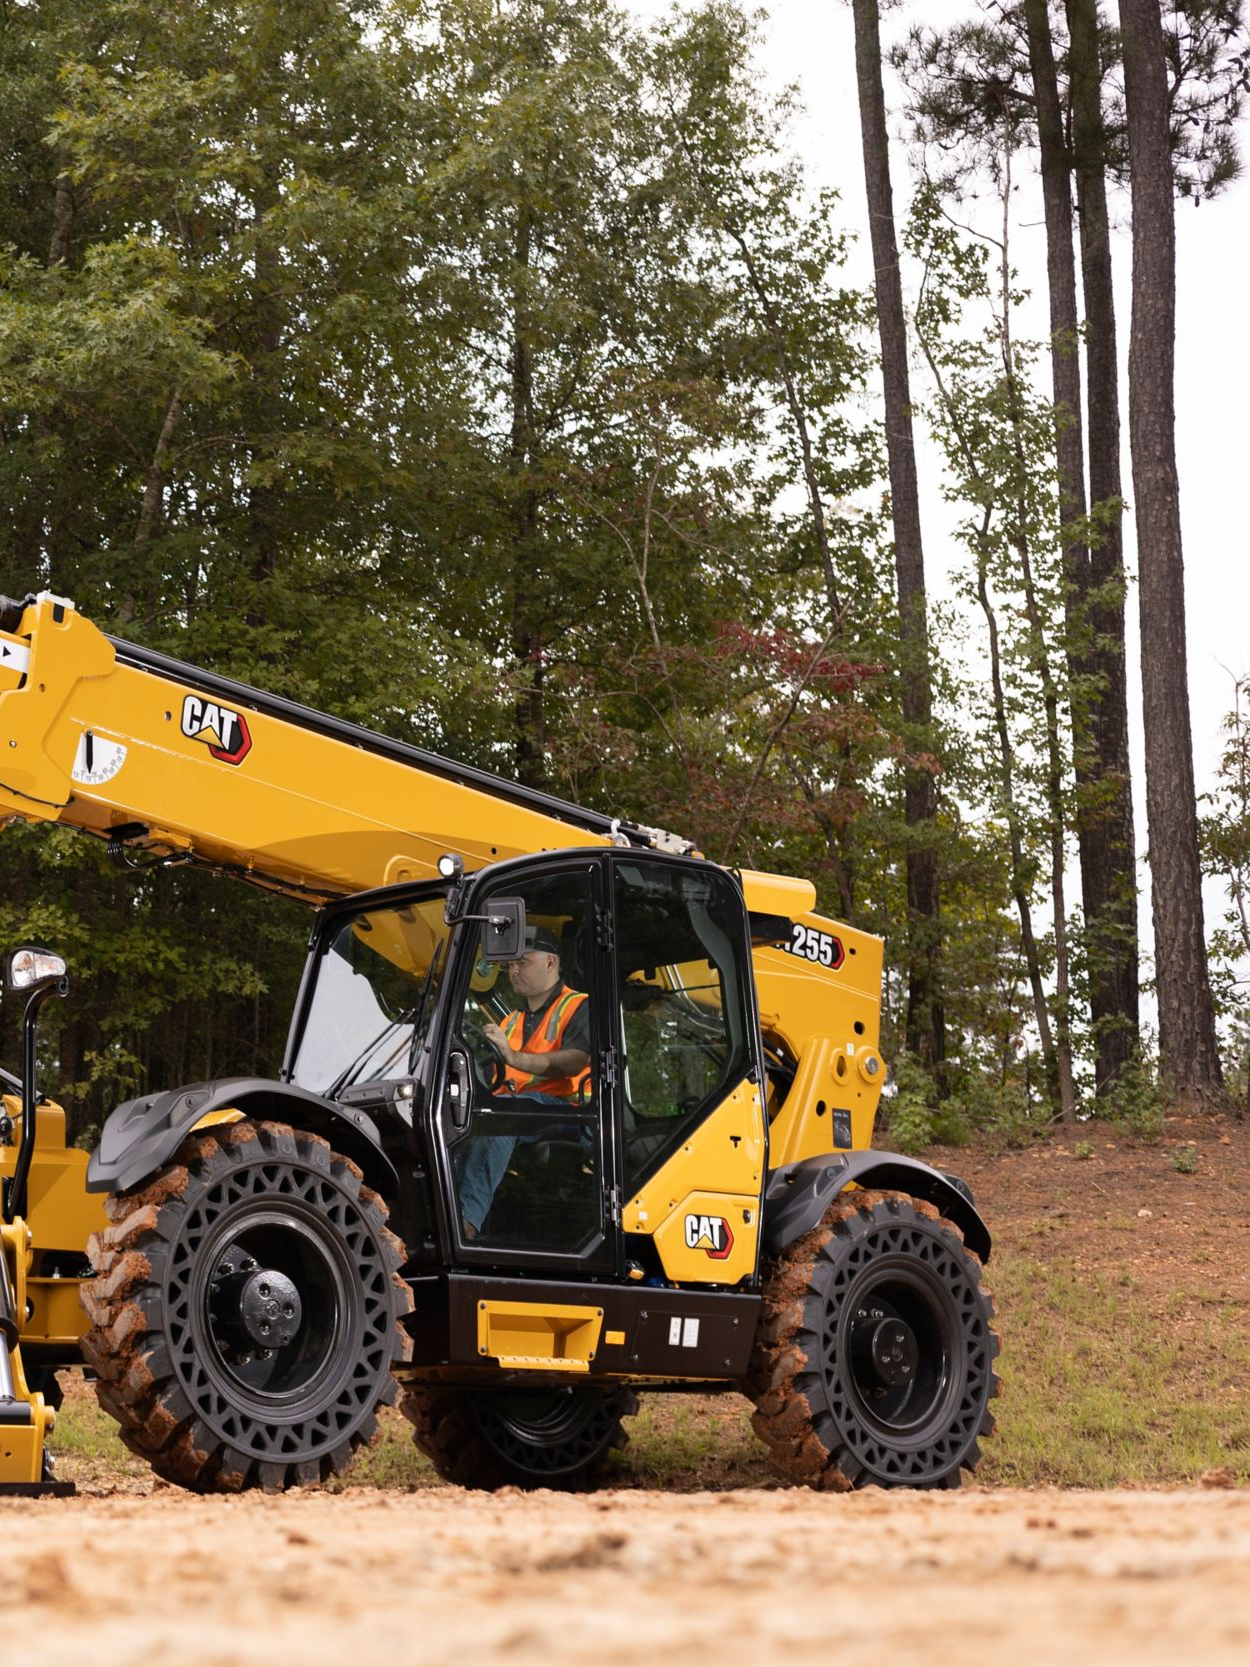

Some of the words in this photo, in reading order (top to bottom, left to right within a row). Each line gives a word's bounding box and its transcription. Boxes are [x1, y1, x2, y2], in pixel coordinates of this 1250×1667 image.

[182, 695, 238, 751] CAT
[776, 924, 833, 966] 255
[685, 1214, 723, 1250] CAT
